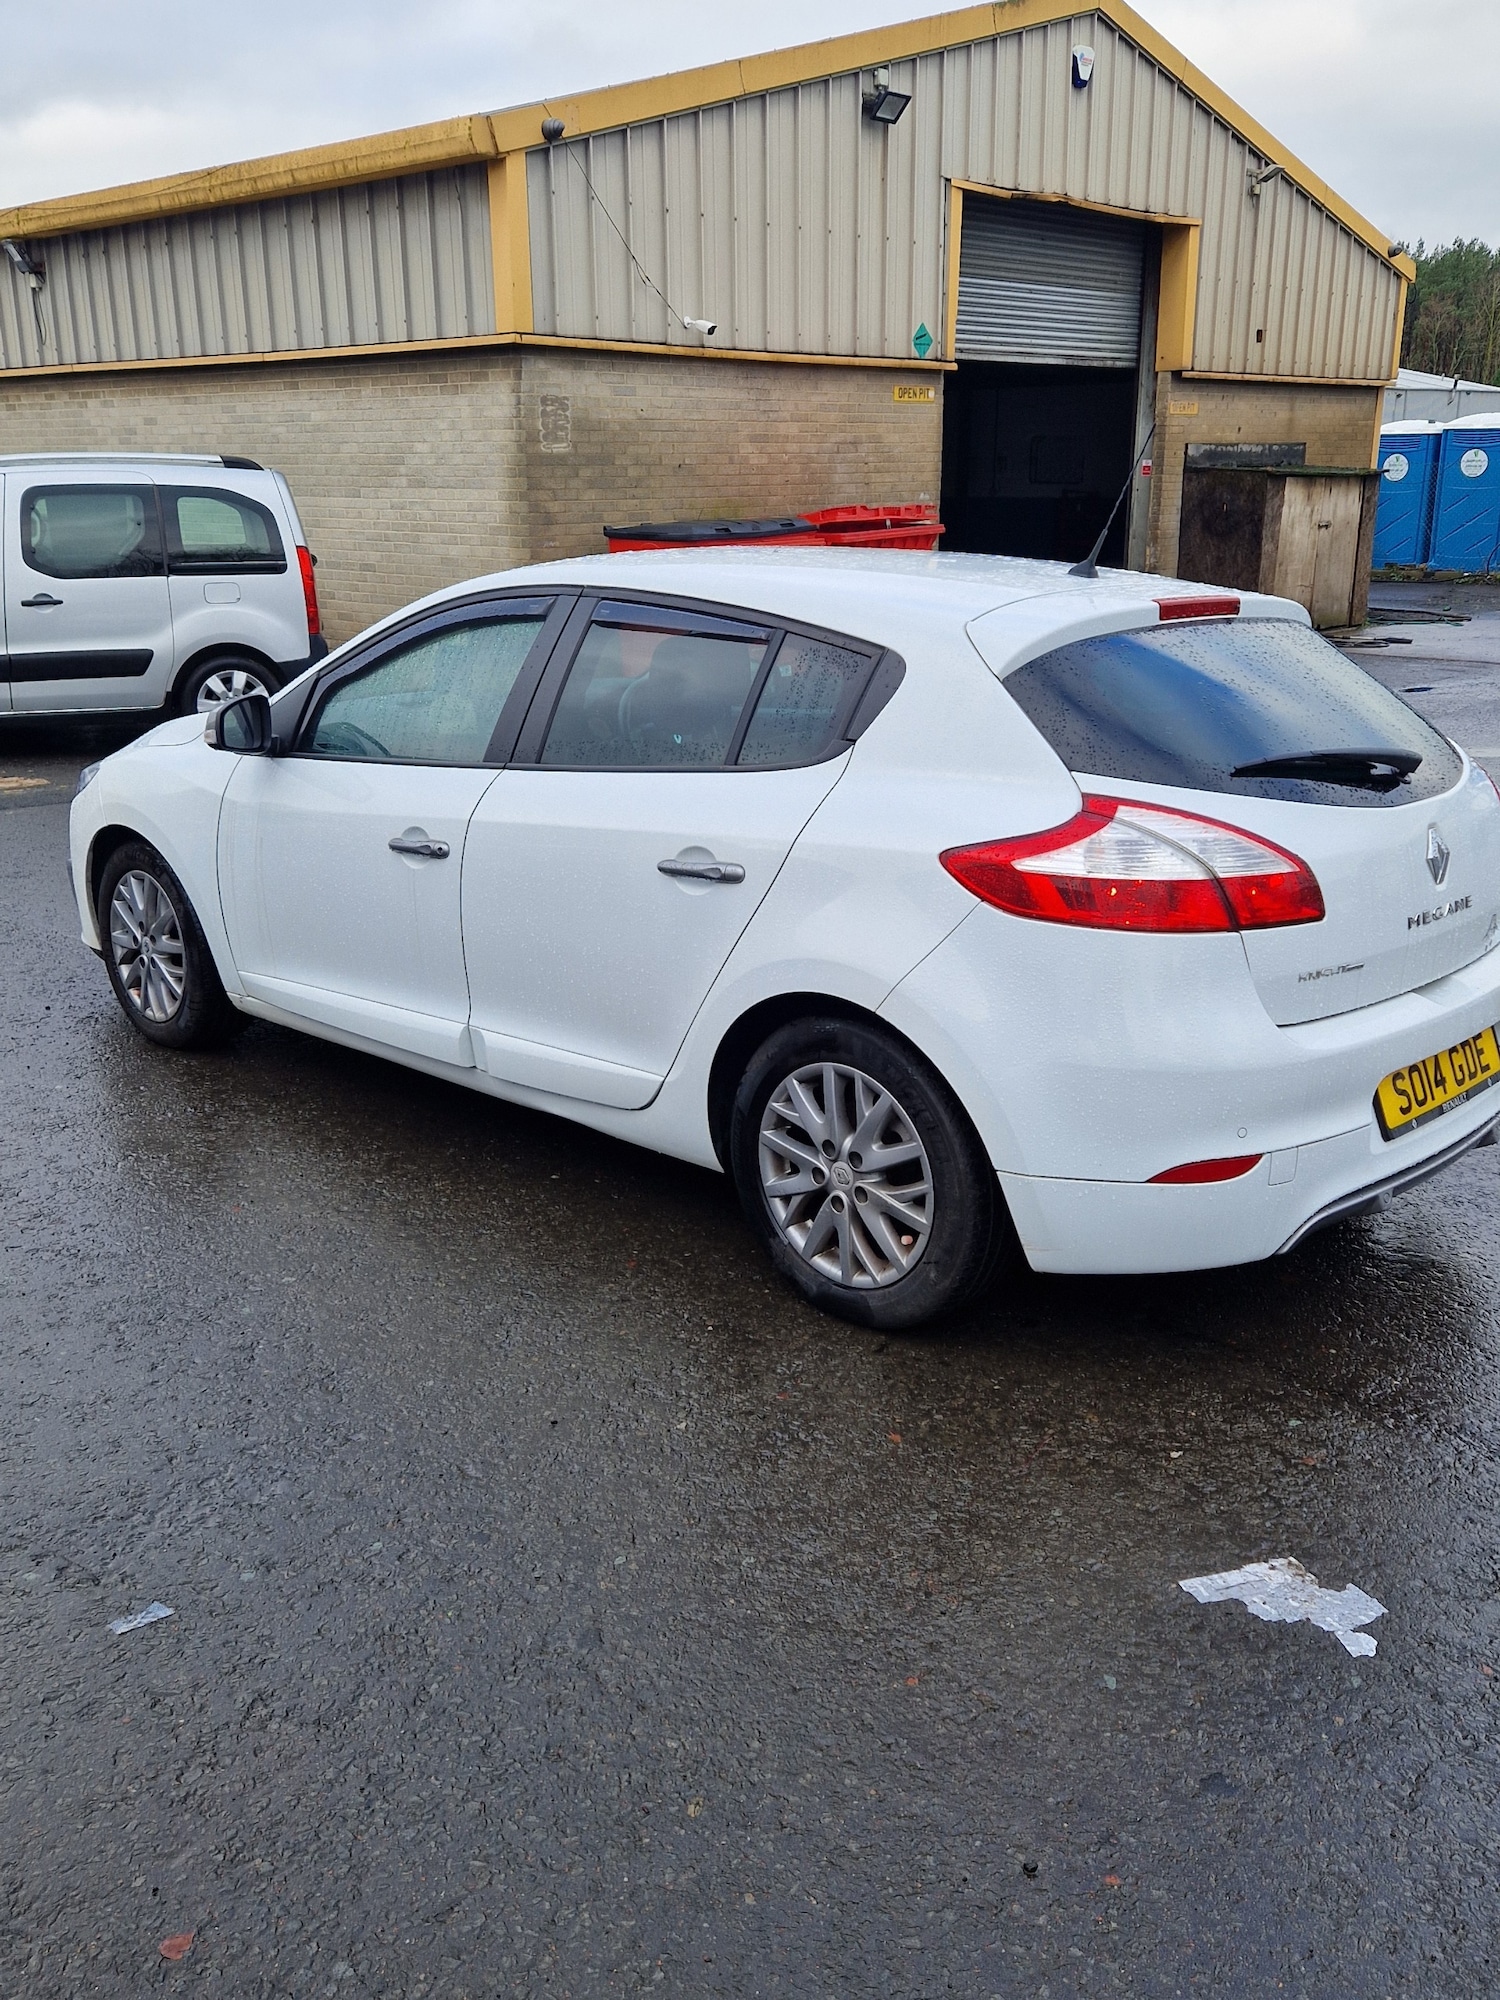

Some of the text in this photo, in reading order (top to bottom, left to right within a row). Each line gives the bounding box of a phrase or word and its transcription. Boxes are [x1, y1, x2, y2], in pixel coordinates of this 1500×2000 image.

[898, 387, 930, 399] OPEN PIT
[1407, 895, 1473, 930] MEGANE
[1392, 1032, 1491, 1116] SO14 GDE
[1442, 1092, 1468, 1112] RENAULT
